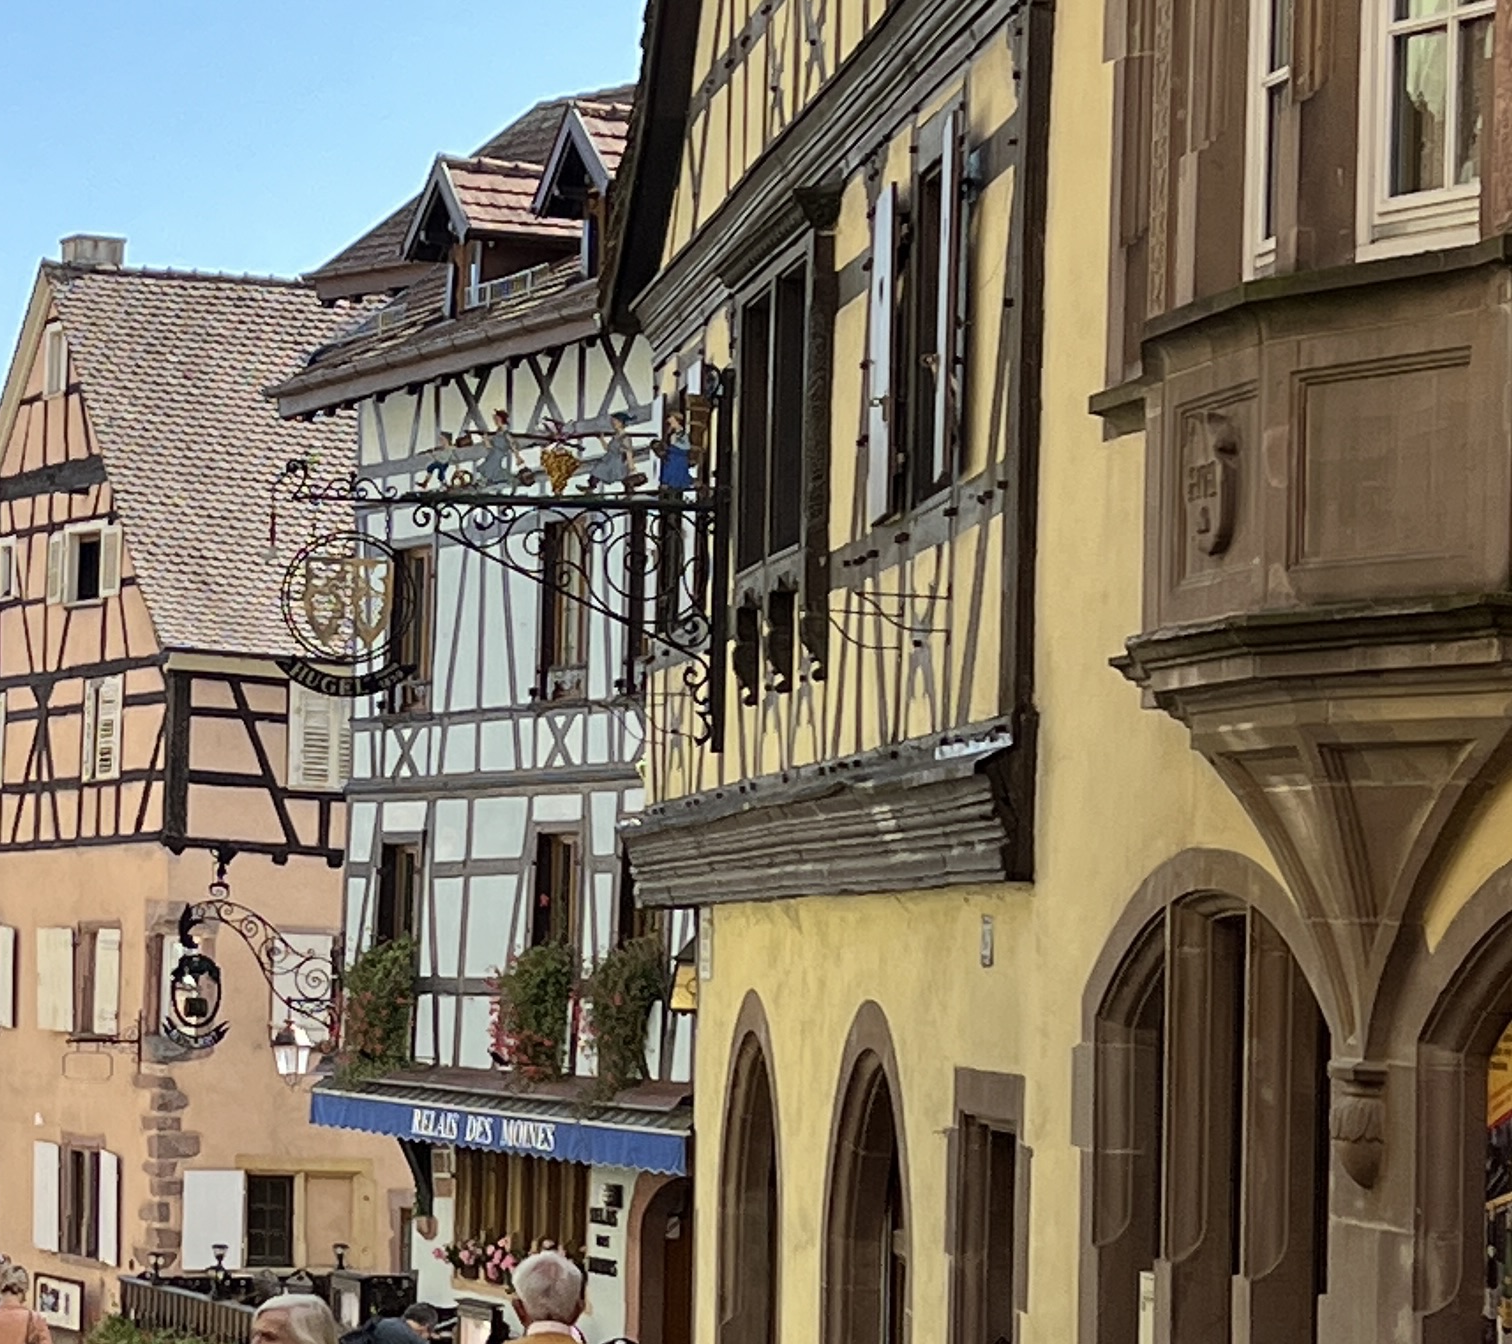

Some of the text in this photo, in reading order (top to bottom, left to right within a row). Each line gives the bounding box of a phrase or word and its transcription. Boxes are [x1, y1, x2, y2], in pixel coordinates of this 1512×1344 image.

[289, 661, 370, 696] HUGEL
[411, 1108, 556, 1152] RELAIS DES MOINES
